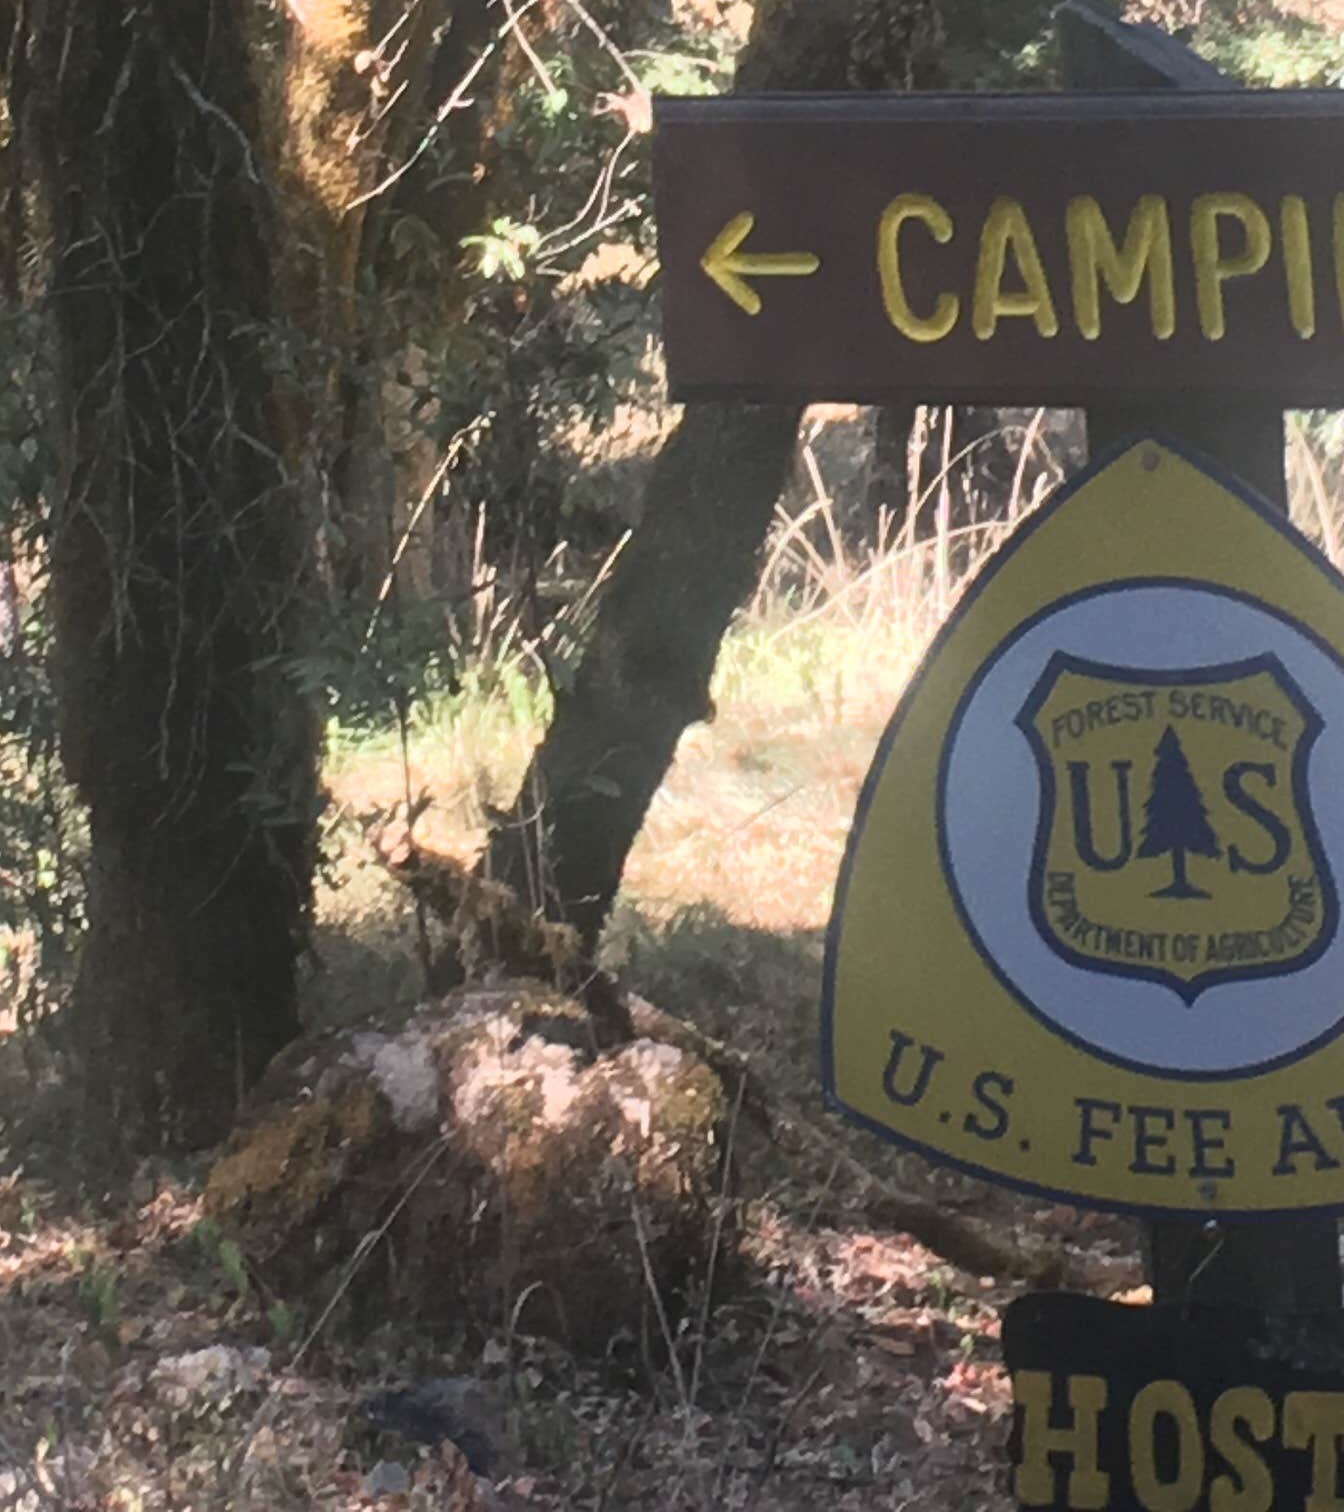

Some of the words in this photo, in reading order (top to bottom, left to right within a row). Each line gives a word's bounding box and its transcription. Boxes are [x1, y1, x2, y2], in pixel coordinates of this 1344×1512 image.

[1051, 690, 1156, 750] FOREST
[1167, 689, 1290, 752] SERVICE
[1047, 870, 1168, 960] DEPARTMENT
[1172, 931, 1200, 964] OF
[880, 1029, 1032, 1152] U.S.
[1071, 1096, 1236, 1179] FEE
